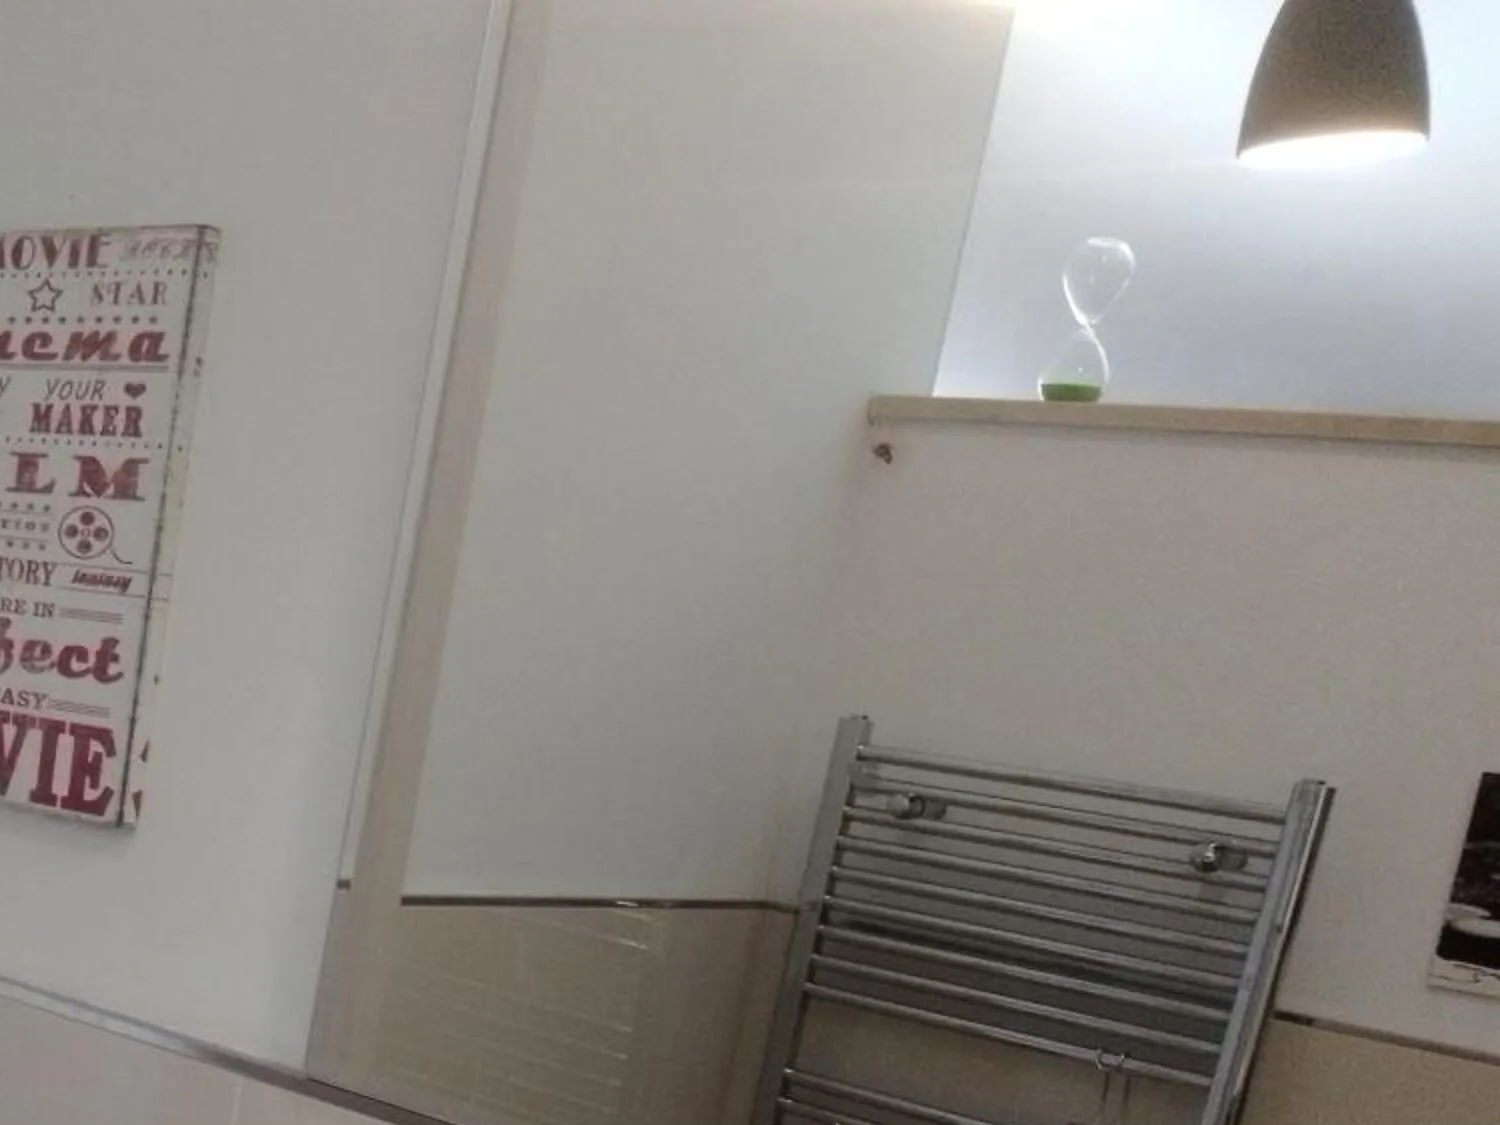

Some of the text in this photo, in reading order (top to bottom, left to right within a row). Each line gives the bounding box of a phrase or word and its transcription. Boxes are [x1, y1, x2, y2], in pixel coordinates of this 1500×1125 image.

[90, 281, 168, 306] STAR
[44, 378, 106, 401] YOUR
[29, 402, 144, 438] MAKER
[33, 600, 56, 618] IN
